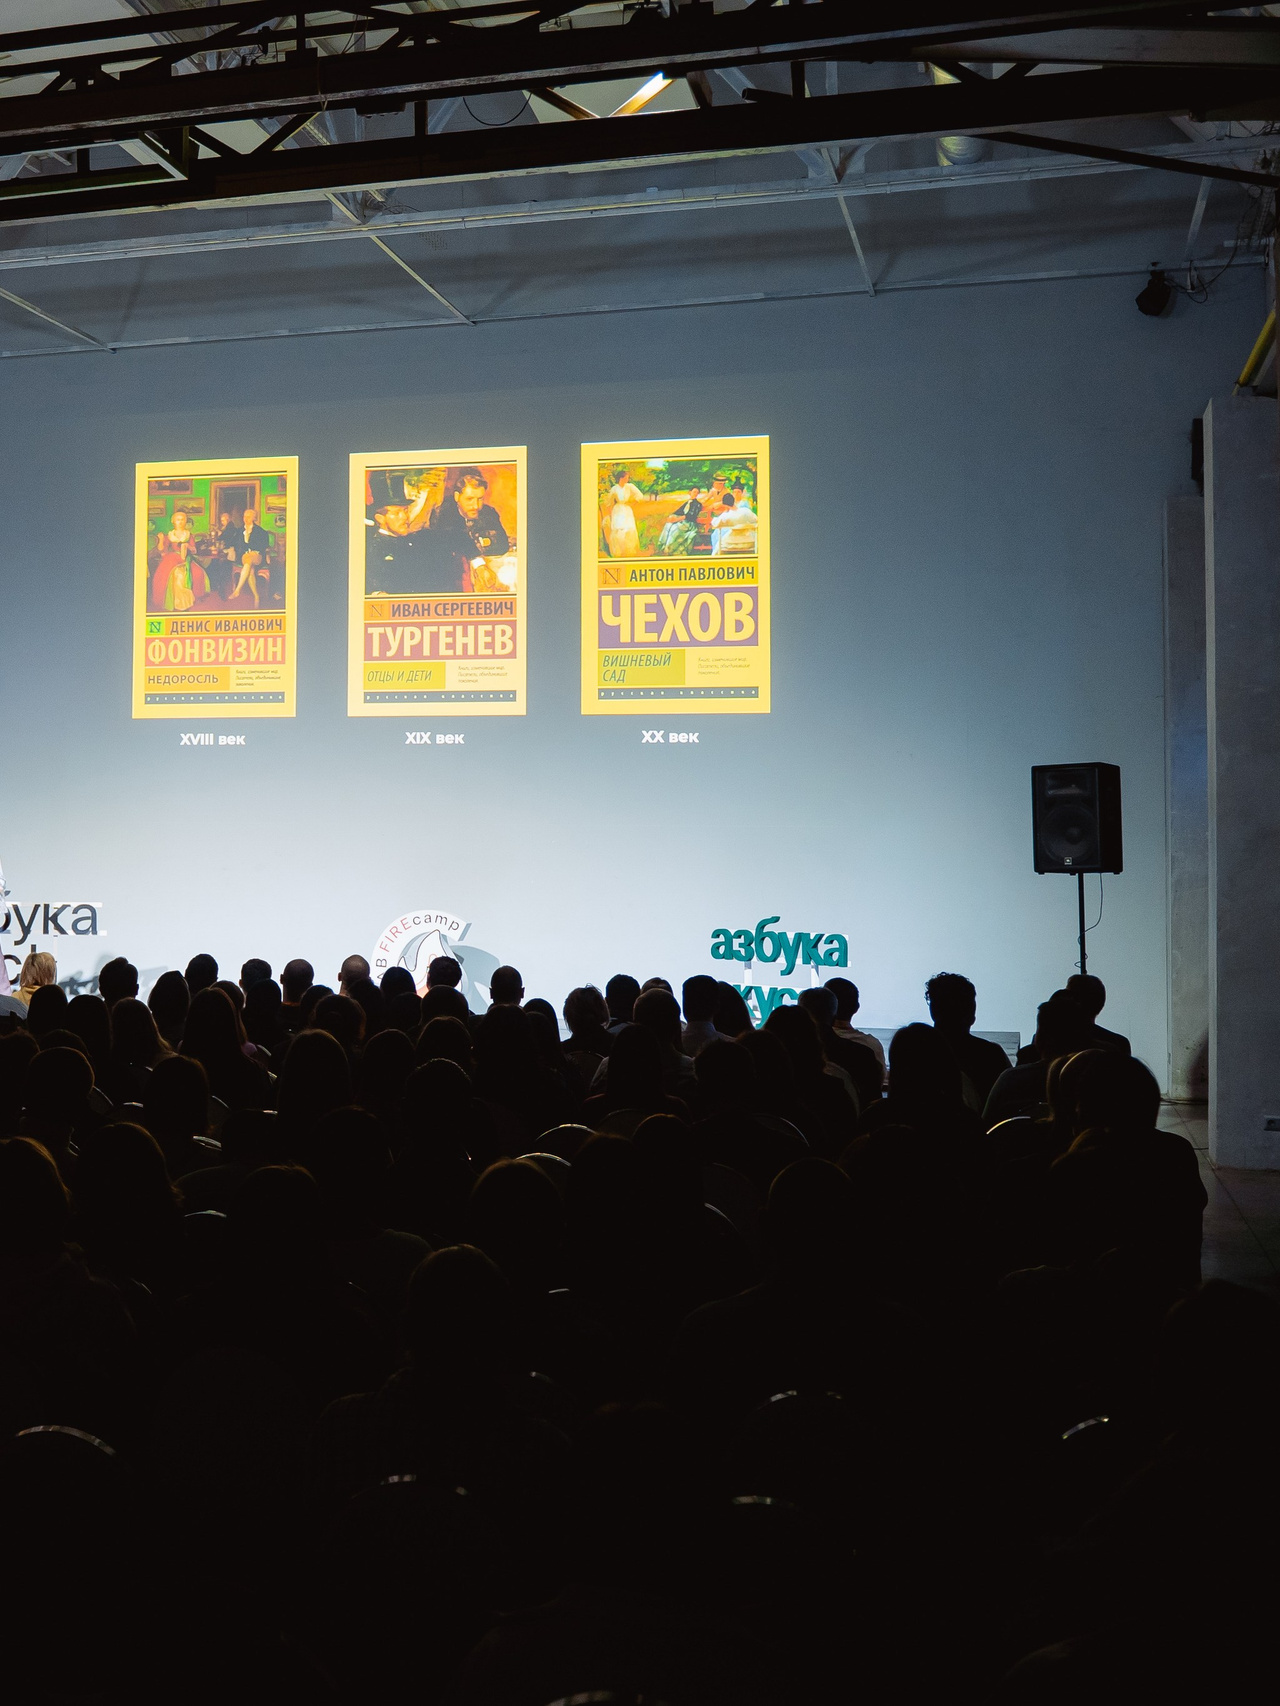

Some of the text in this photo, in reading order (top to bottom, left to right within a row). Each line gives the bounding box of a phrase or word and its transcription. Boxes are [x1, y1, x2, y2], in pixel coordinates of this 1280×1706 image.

[603, 568, 620, 584] N
[629, 566, 755, 582] АНТОН ПАВЛОВИЧ
[391, 601, 514, 617] ИВАН СЕРГЕЕВИЧ
[601, 591, 755, 643] ЧЕХОВ
[149, 621, 161, 633] N
[170, 618, 282, 635] ДЕНИС ИВАНОВИЧ
[367, 624, 514, 657] ТУРГЕНЕВ
[147, 637, 282, 664] ФОНВИЗИН
[603, 651, 672, 668] ВИШНЕВЫЙ
[148, 674, 219, 686] НЕДОРОСЛЬ
[367, 669, 432, 683] ОТЦЫ И ДЕТИ
[602, 669, 626, 684] САД
[180, 733, 246, 745] XVIII век
[405, 731, 465, 744] XIX век
[641, 730, 699, 743] XX век
[379, 914, 460, 953] FIREcamp
[710, 916, 849, 977] азбука
[733, 984, 799, 1030] кус
